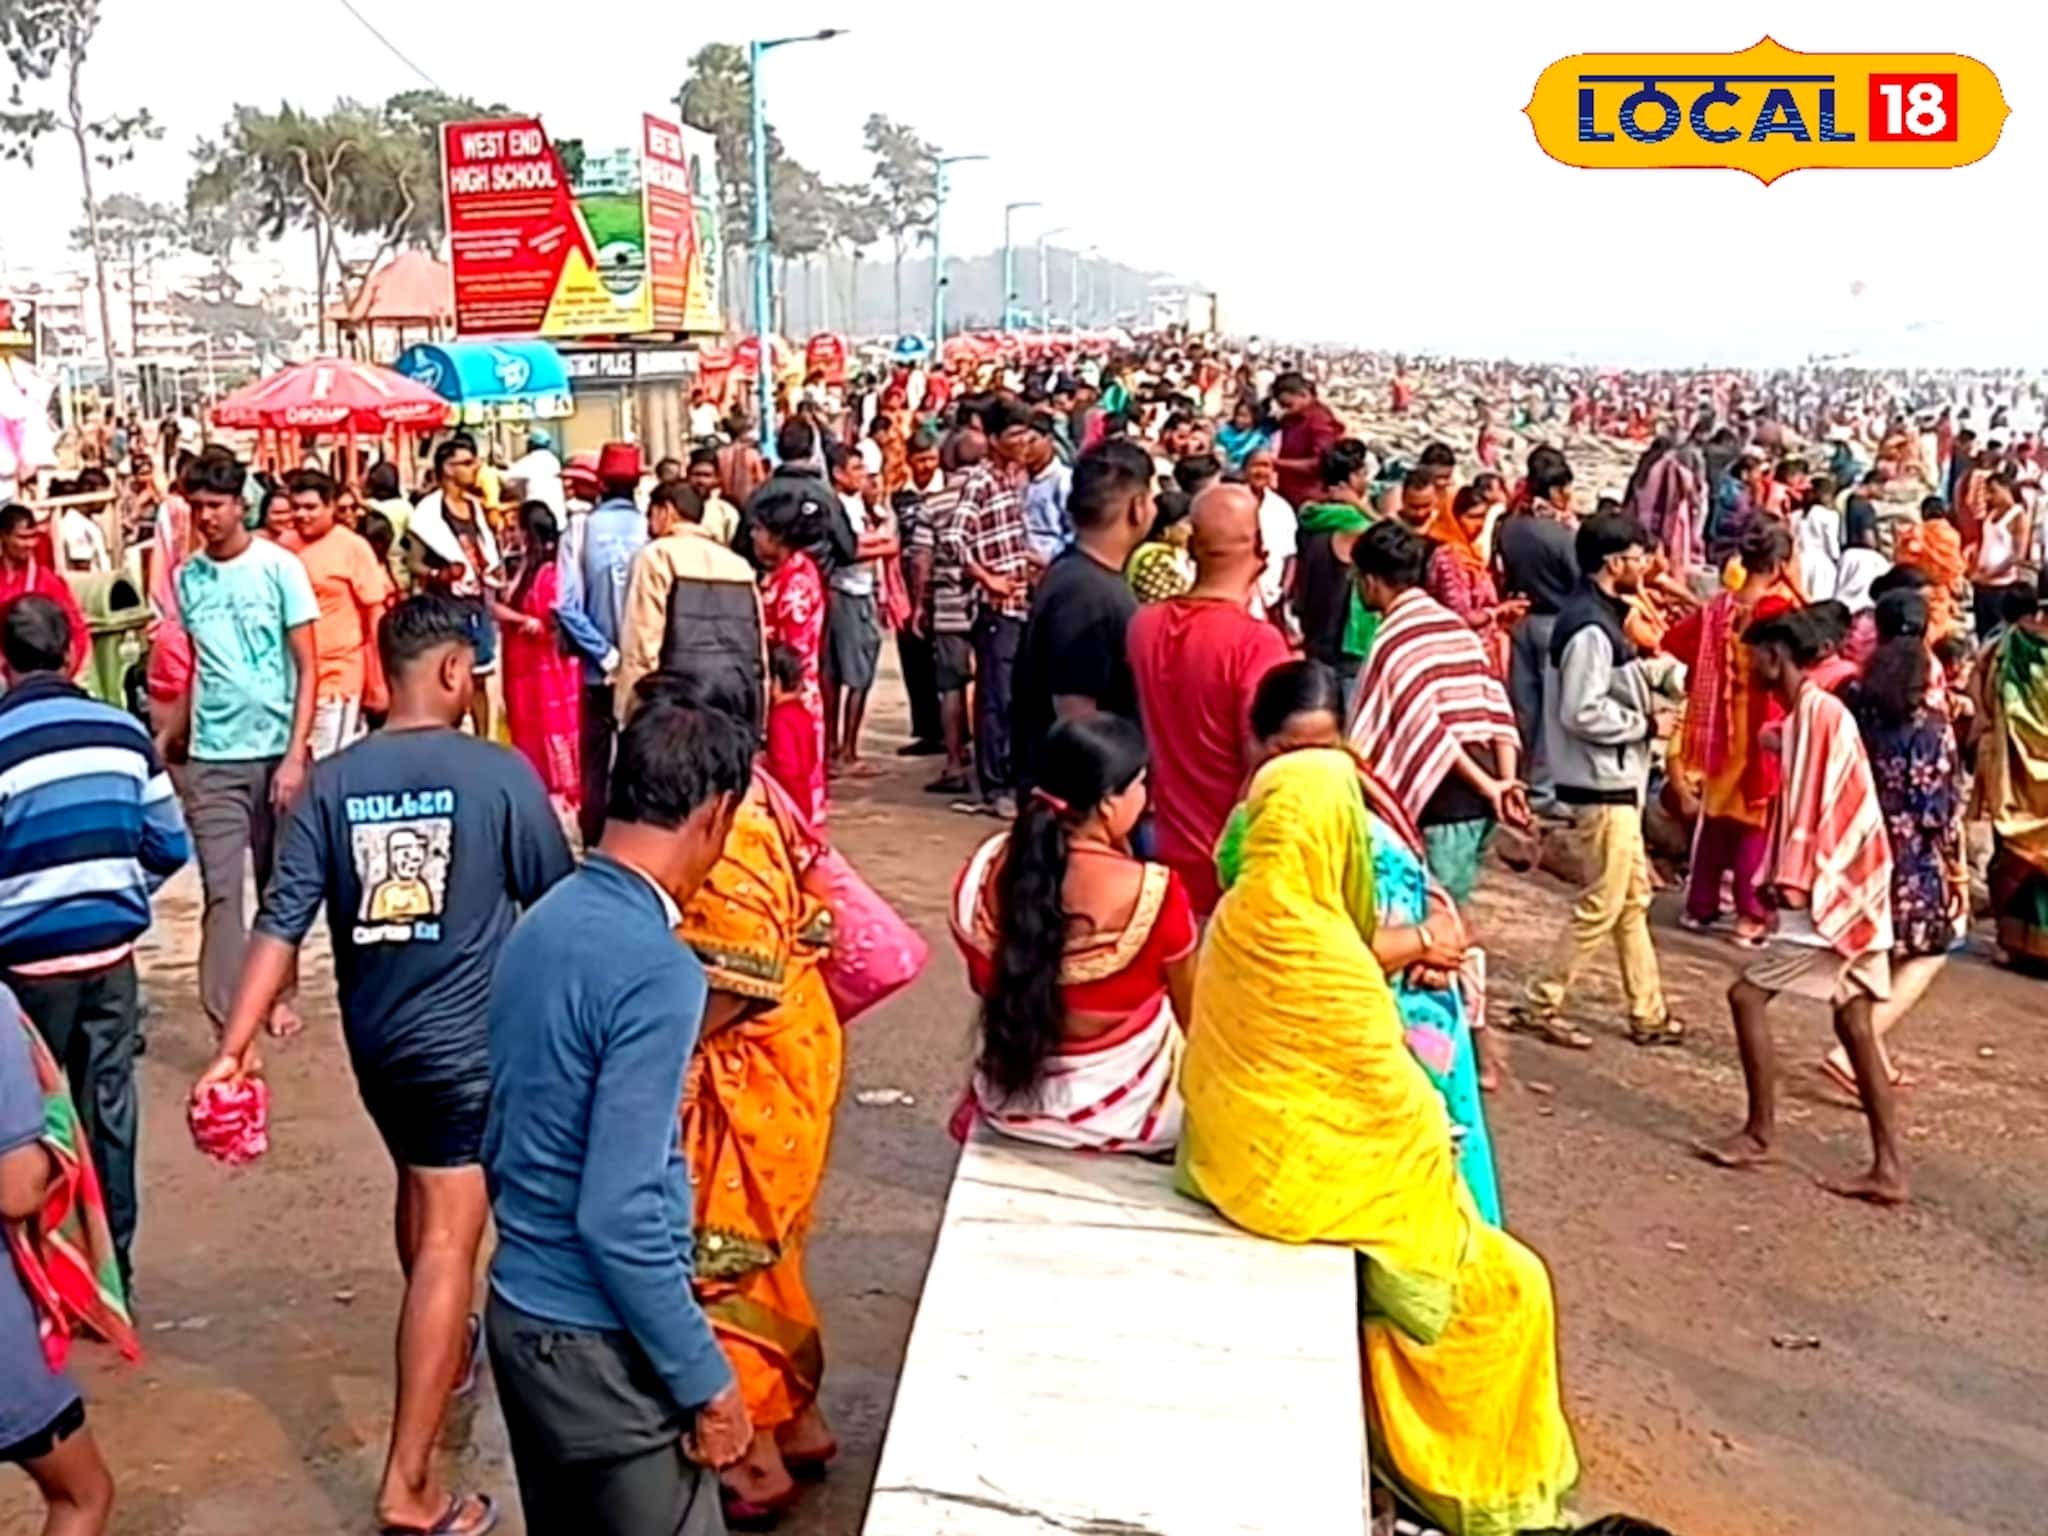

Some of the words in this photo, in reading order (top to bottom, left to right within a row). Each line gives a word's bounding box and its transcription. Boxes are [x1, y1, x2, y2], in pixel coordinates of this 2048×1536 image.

[461, 131, 505, 160] WEST
[509, 128, 542, 156] END
[450, 165, 490, 194] HIGH
[492, 160, 557, 191] SCHOOL
